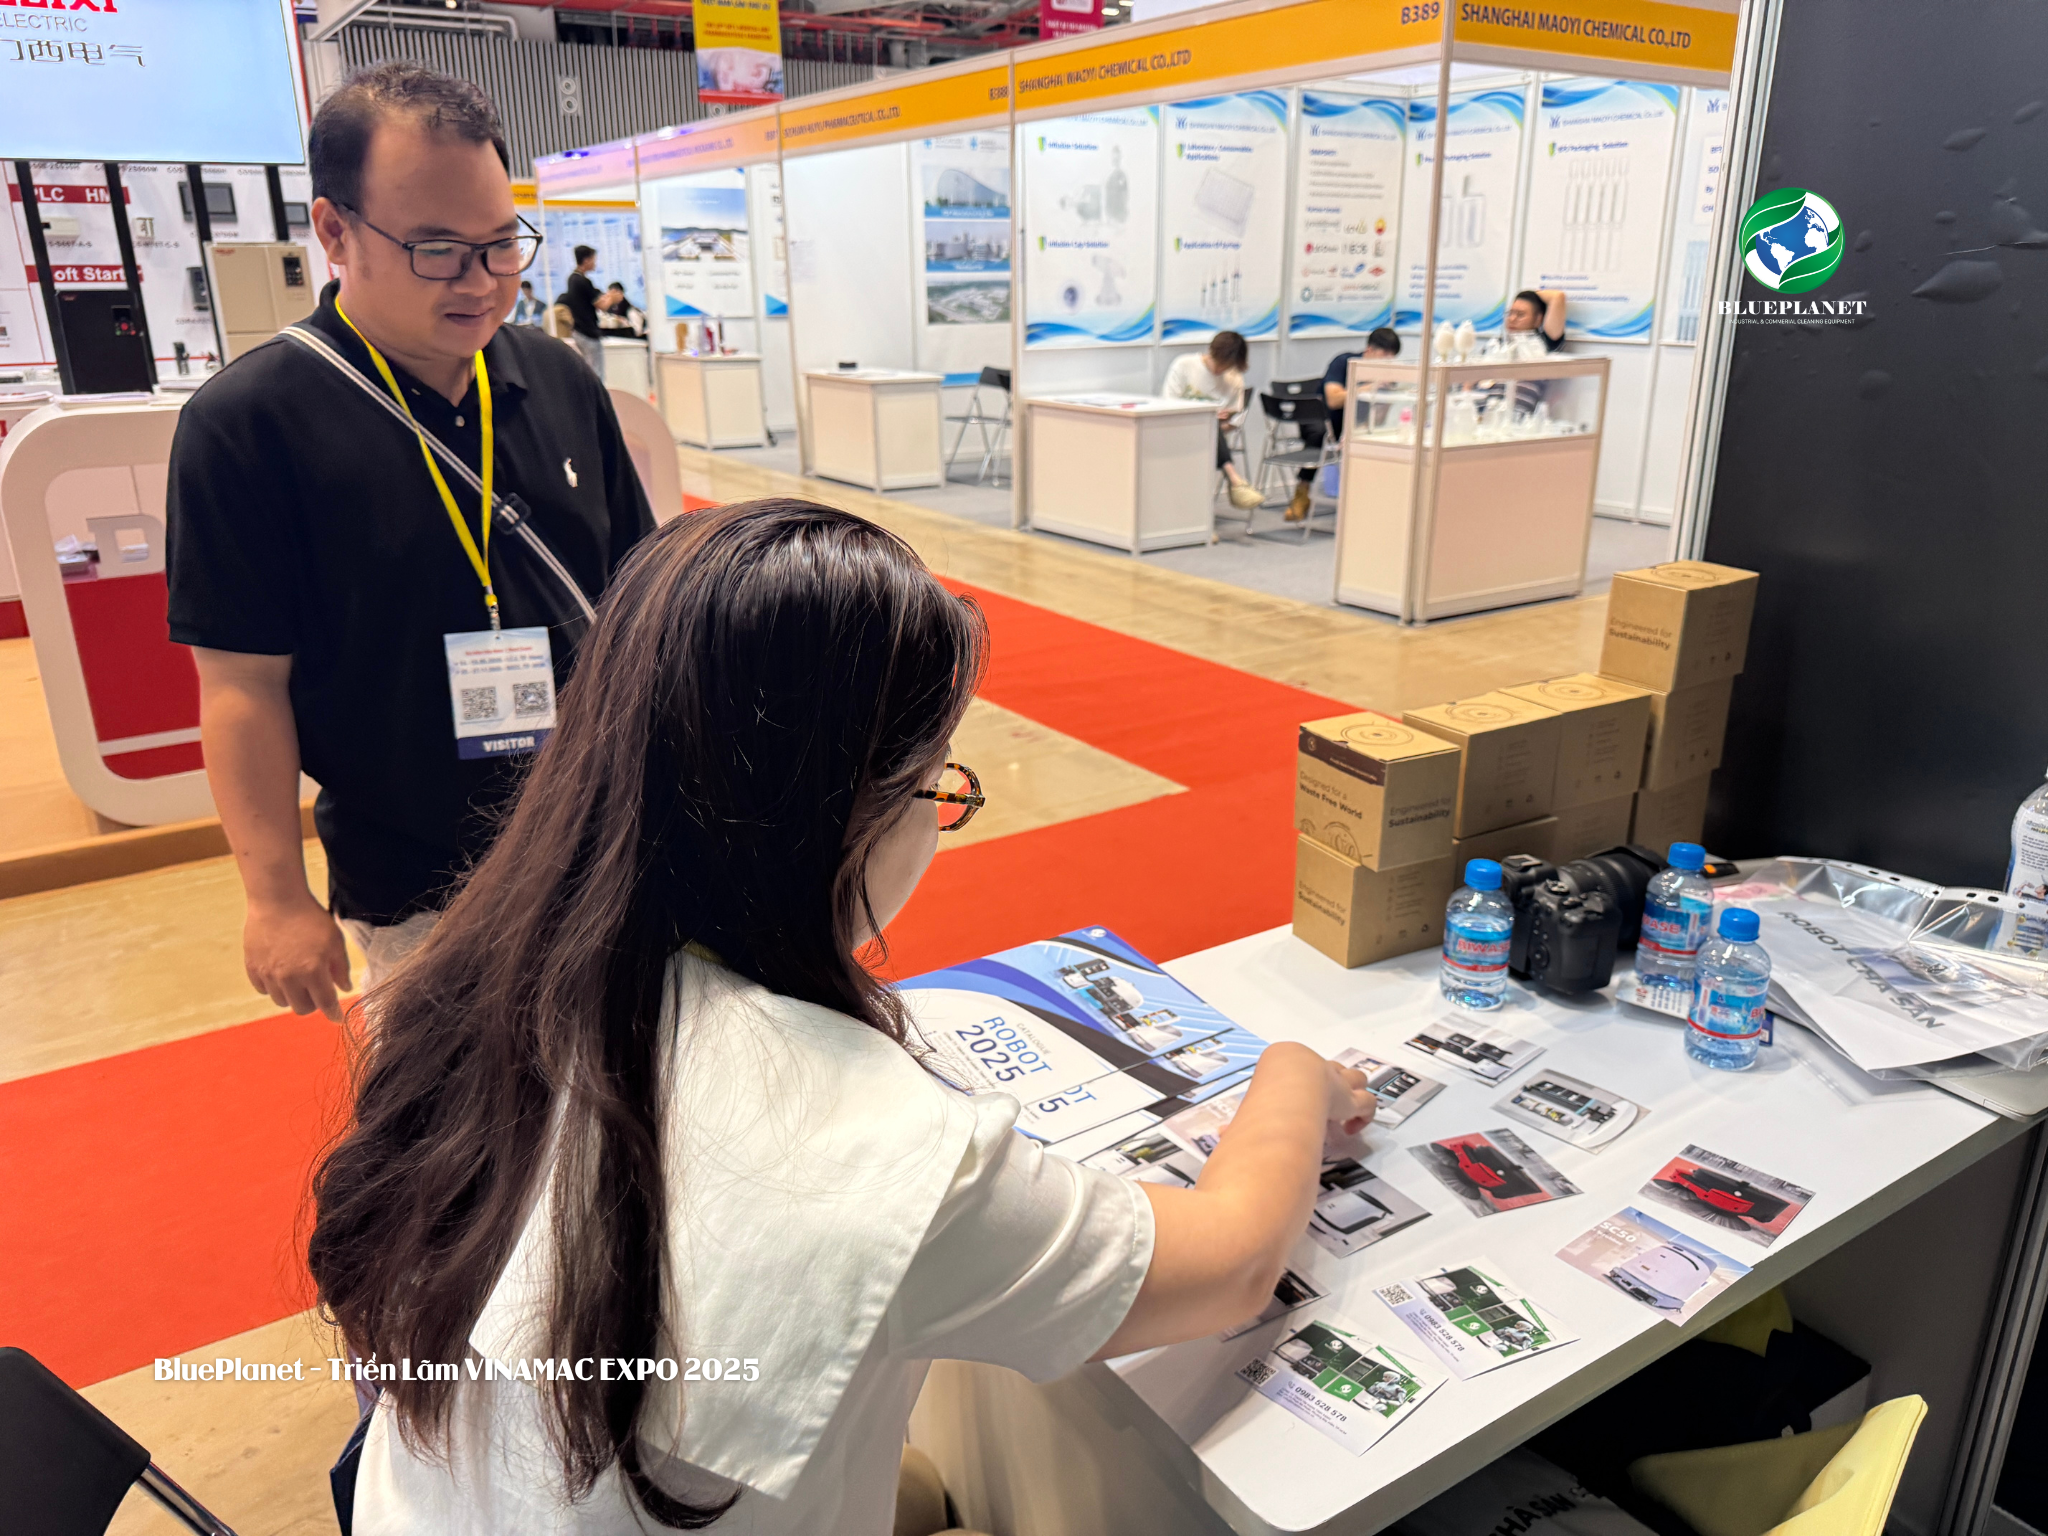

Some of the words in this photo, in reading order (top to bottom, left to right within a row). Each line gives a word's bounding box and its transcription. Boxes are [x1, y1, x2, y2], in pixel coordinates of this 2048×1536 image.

[0, 13, 88, 32] LECTRIC
[1401, 2, 1440, 25] B389
[1461, 3, 1535, 30] SHANGHAI
[1538, 14, 1581, 35] MAOYI
[1583, 19, 1646, 43] CHEMICAL
[1648, 28, 1692, 49] CO.,LTD
[54, 266, 79, 281] oft
[1608, 628, 1671, 651] Sustainability
[1610, 617, 1658, 635] Engineered
[1660, 628, 1672, 638] for
[483, 737, 535, 752] VISITOR
[1300, 770, 1331, 794] Designed
[1331, 786, 1341, 797] for
[1299, 783, 1320, 799] Waste
[1321, 794, 1338, 808] Free
[1339, 801, 1363, 820] World
[1390, 799, 1439, 816] Engineered
[1388, 808, 1450, 828] Sustainability
[1778, 911, 1851, 954] ROBOT
[983, 1016, 1053, 1074] ROBOT
[1016, 1022, 1051, 1055] CATALOGUE
[955, 1024, 1026, 1082] 2025
[1600, 1221, 1637, 1243] SC50
[1424, 1314, 1442, 1330] 0983
[1439, 1328, 1453, 1341] 528
[1295, 1386, 1316, 1402] 0983
[1314, 1398, 1331, 1412] 528
[1330, 1409, 1347, 1422] 578
[1489, 1505, 1542, 1536] HÀ
